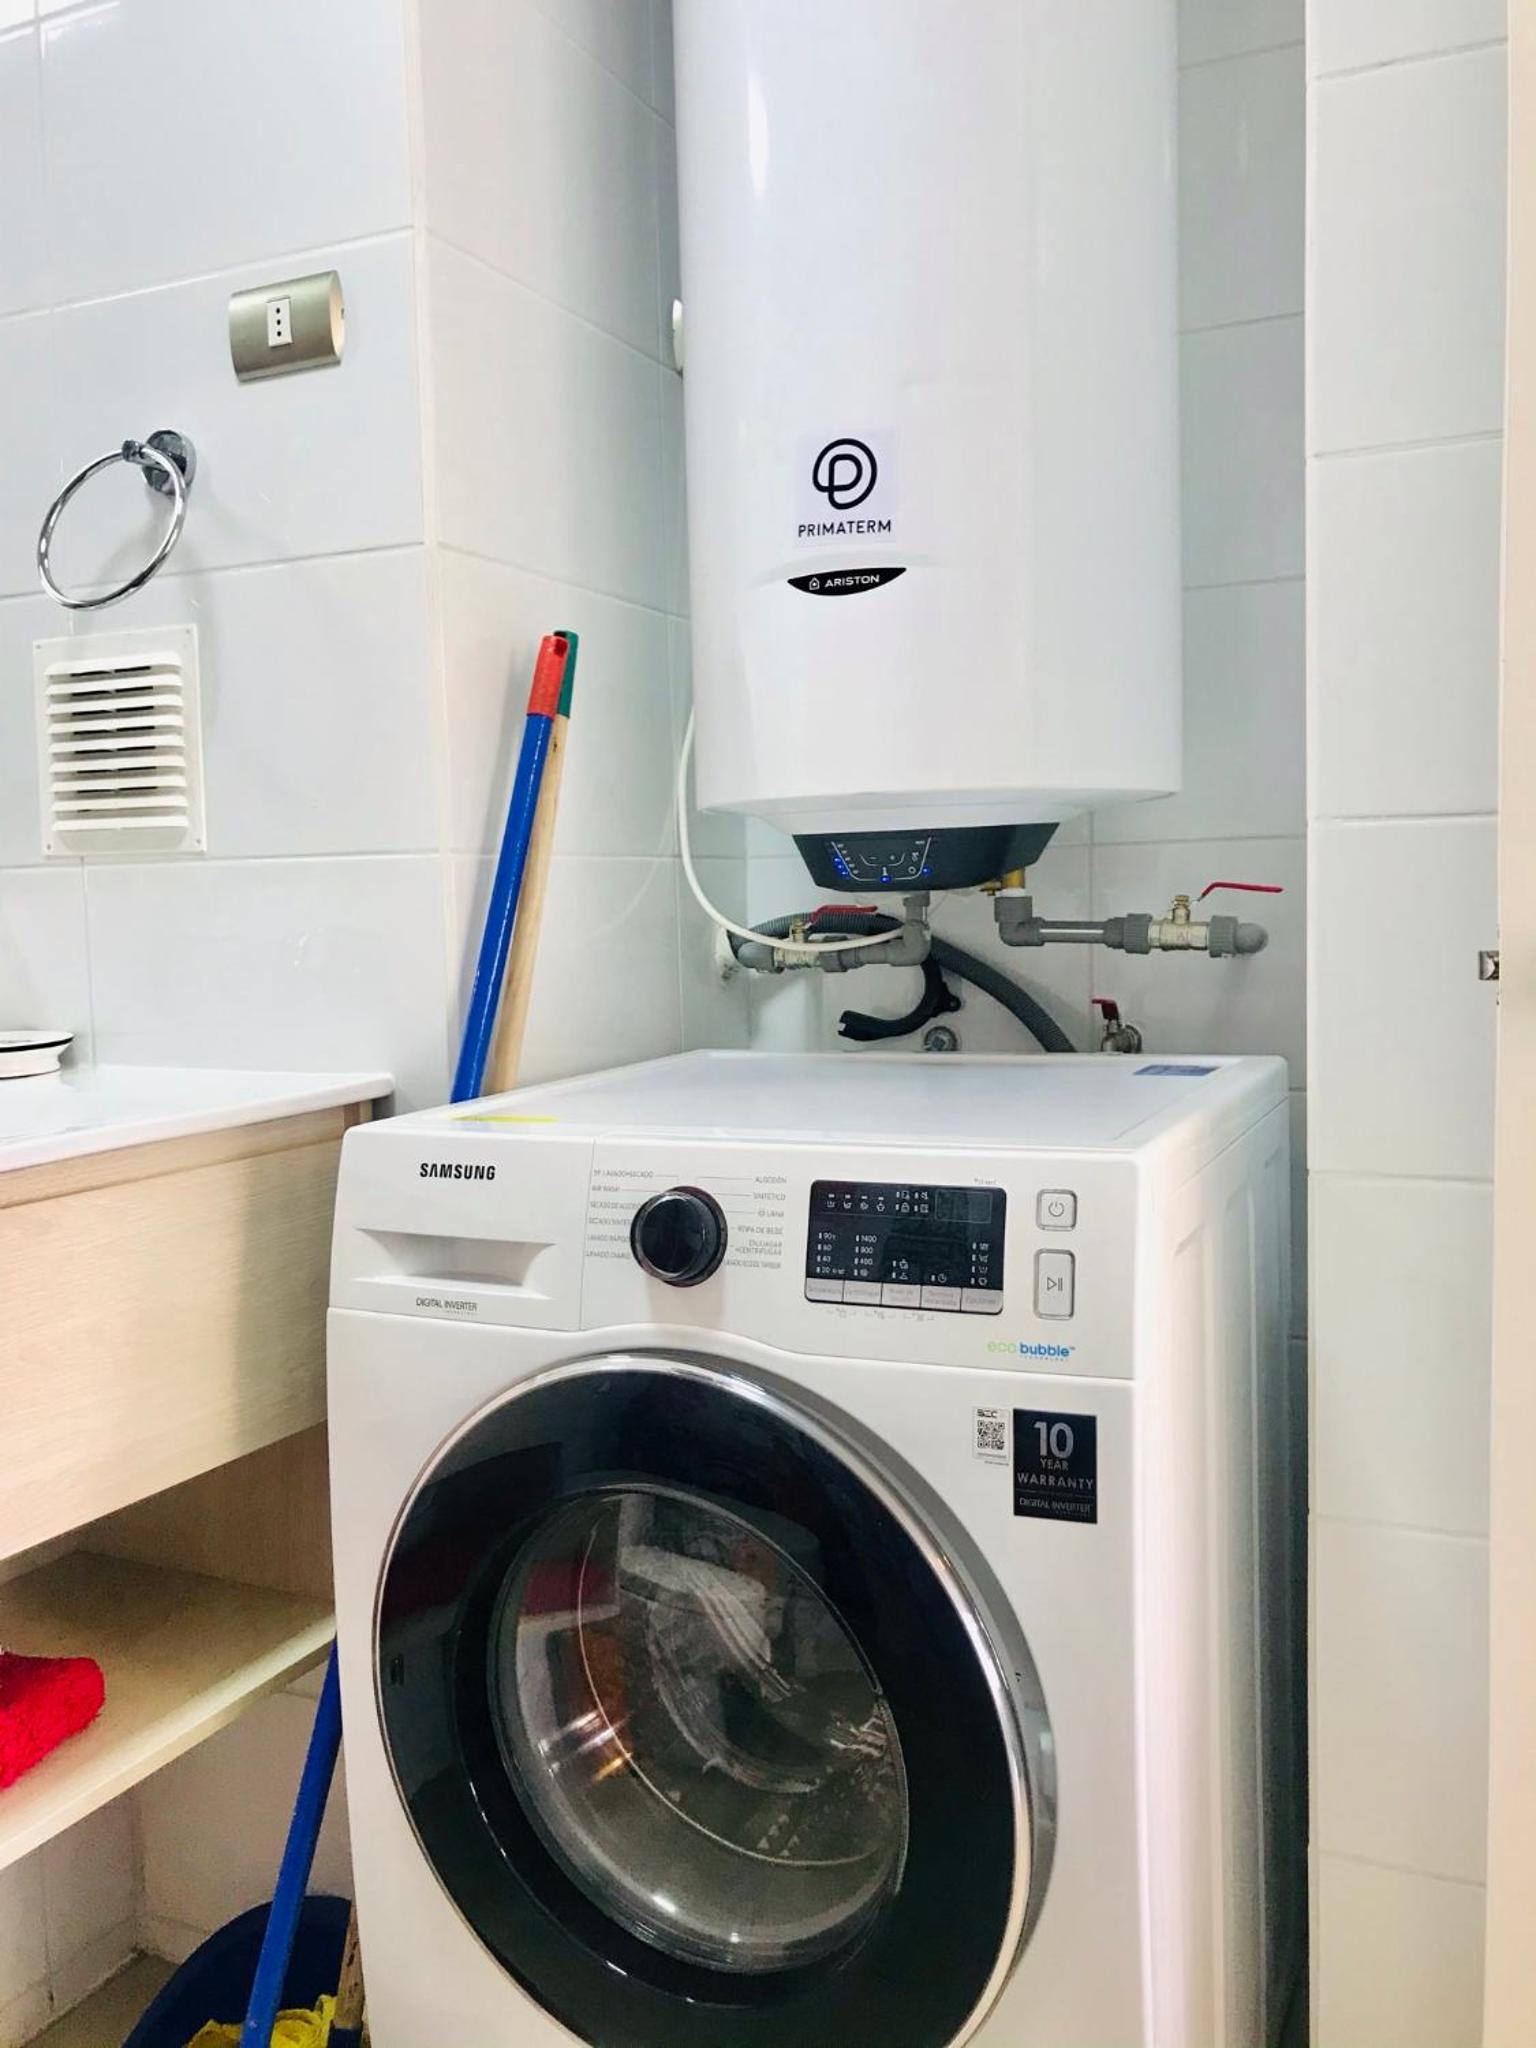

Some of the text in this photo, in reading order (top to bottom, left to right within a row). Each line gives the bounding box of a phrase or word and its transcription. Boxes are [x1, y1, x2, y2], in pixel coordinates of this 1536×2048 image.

[798, 519, 892, 538] PRIMATERM
[824, 574, 880, 588] ARISTON
[419, 1162, 497, 1181] SAMSUNG
[1033, 1421, 1074, 1459] 10
[1040, 1458, 1069, 1470] YEAR
[1016, 1472, 1094, 1489] WARRANTY
